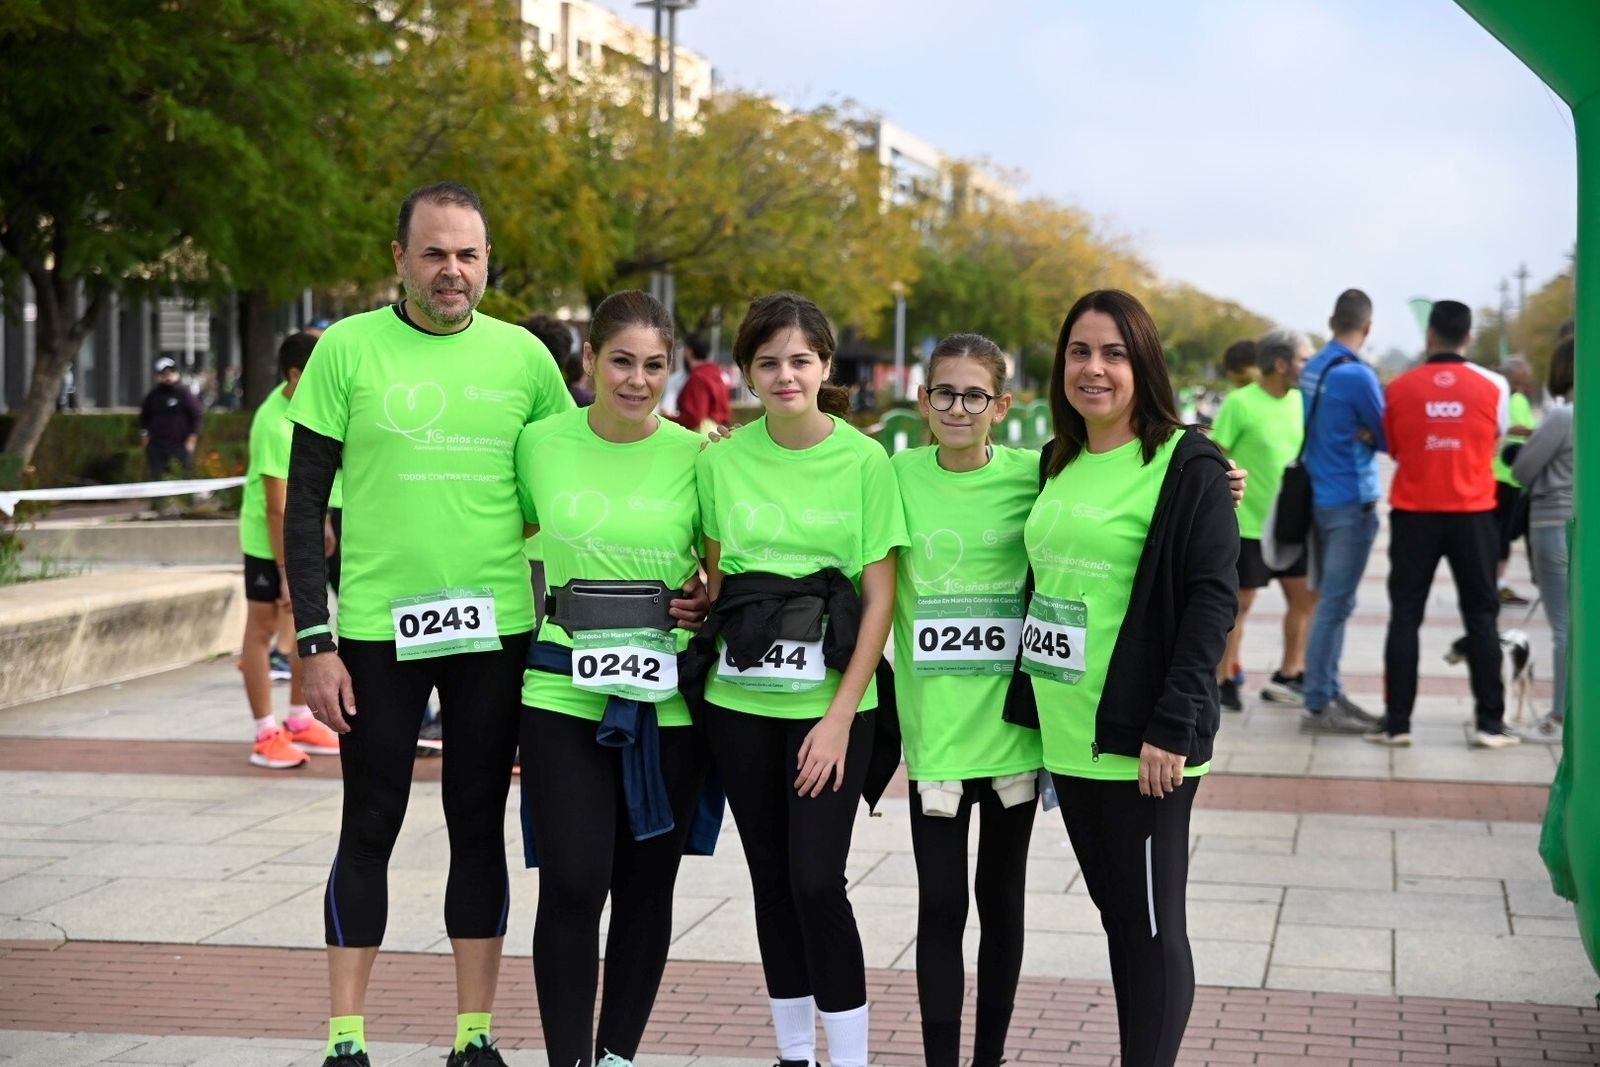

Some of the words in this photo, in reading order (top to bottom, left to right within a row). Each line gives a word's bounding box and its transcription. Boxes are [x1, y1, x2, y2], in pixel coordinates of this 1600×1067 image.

[1425, 401, 1464, 417] UCO
[400, 473, 426, 481] TODOS
[428, 473, 461, 481] CONTRA
[399, 605, 480, 638] 0243
[918, 626, 1006, 652] 0246
[1024, 623, 1071, 659] 0245
[578, 653, 661, 682] 0242
